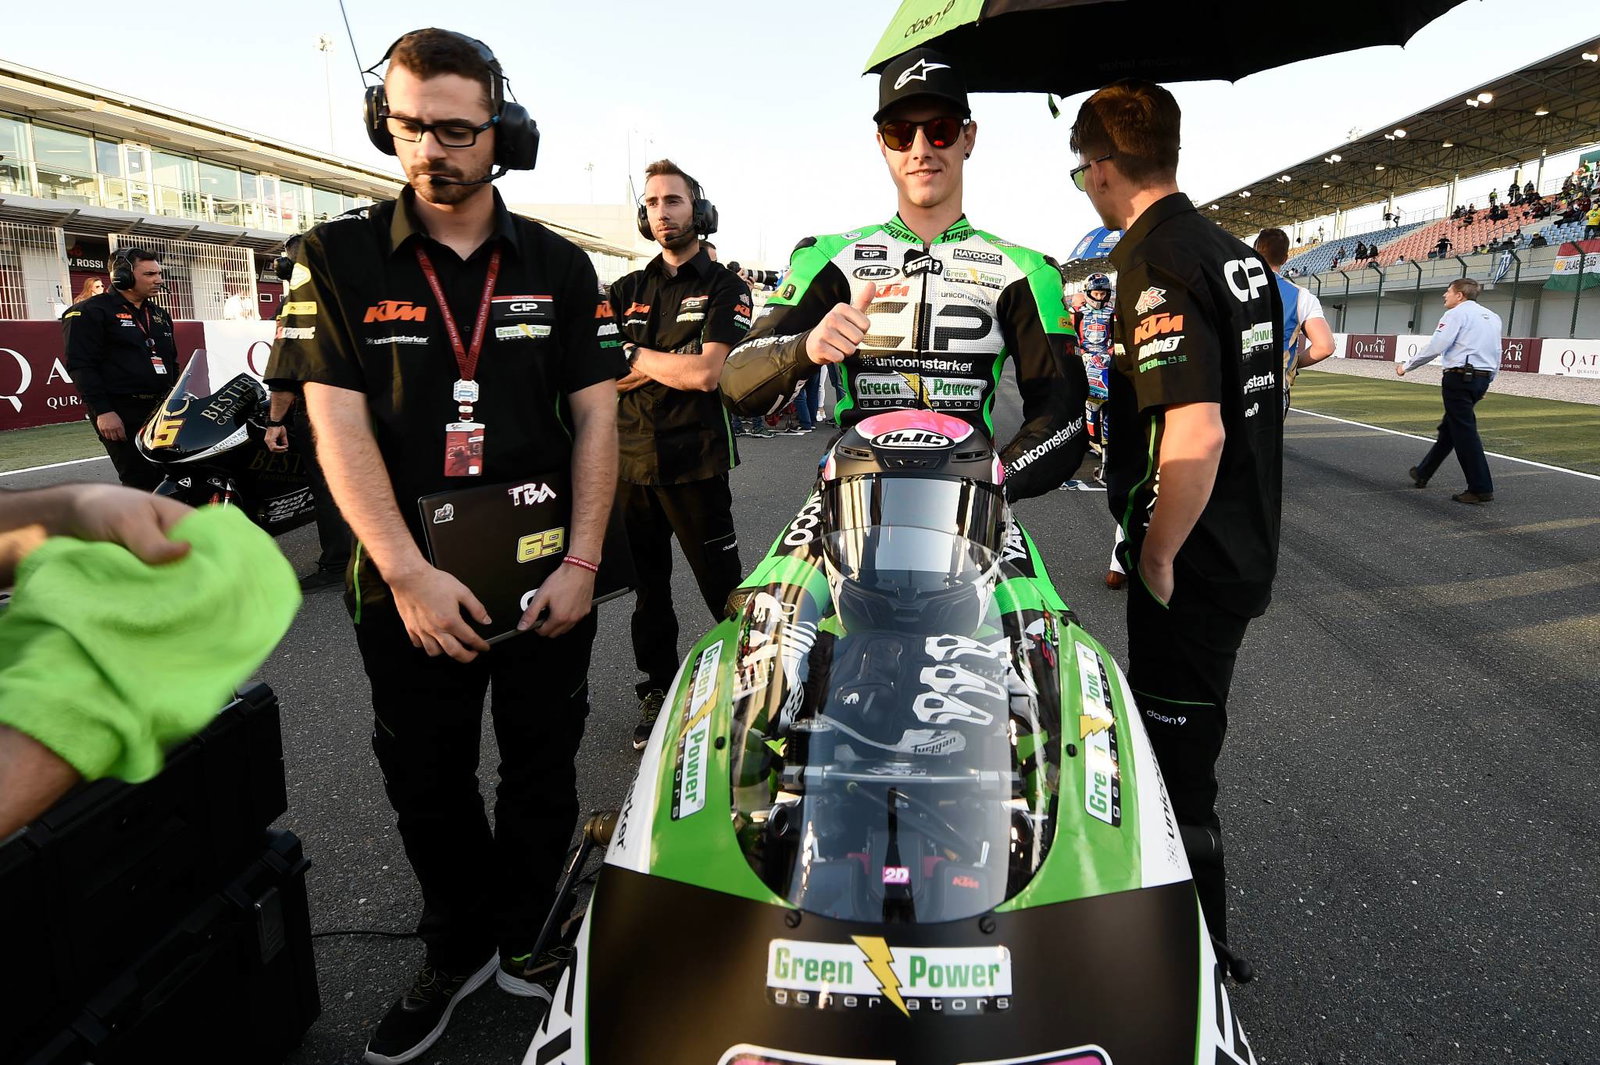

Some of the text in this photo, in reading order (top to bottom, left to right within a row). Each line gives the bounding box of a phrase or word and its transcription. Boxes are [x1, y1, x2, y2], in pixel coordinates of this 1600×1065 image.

[77, 259, 104, 268] ROSSI
[955, 250, 1001, 262] HAYDOCK
[859, 268, 893, 277] HJC
[363, 300, 427, 323] KTM
[510, 302, 538, 312] CIP
[595, 301, 613, 319] KT
[1134, 312, 1184, 345] KTM
[1355, 341, 1385, 358] QATAR
[1561, 350, 1599, 373] QAT
[859, 378, 979, 396] Green Power
[200, 376, 255, 421] BESTER
[862, 399, 980, 408] generators
[881, 432, 945, 445] HJC
[1011, 416, 1083, 471] unicomstarker
[508, 482, 557, 506] TBA
[518, 528, 564, 563] 69
[685, 645, 720, 803] Green Power
[1089, 744, 1107, 815] Gren
[884, 868, 909, 881] 2D
[953, 875, 980, 889] KTM
[775, 947, 1000, 989] Green Power
[775, 990, 1009, 1010] generators
